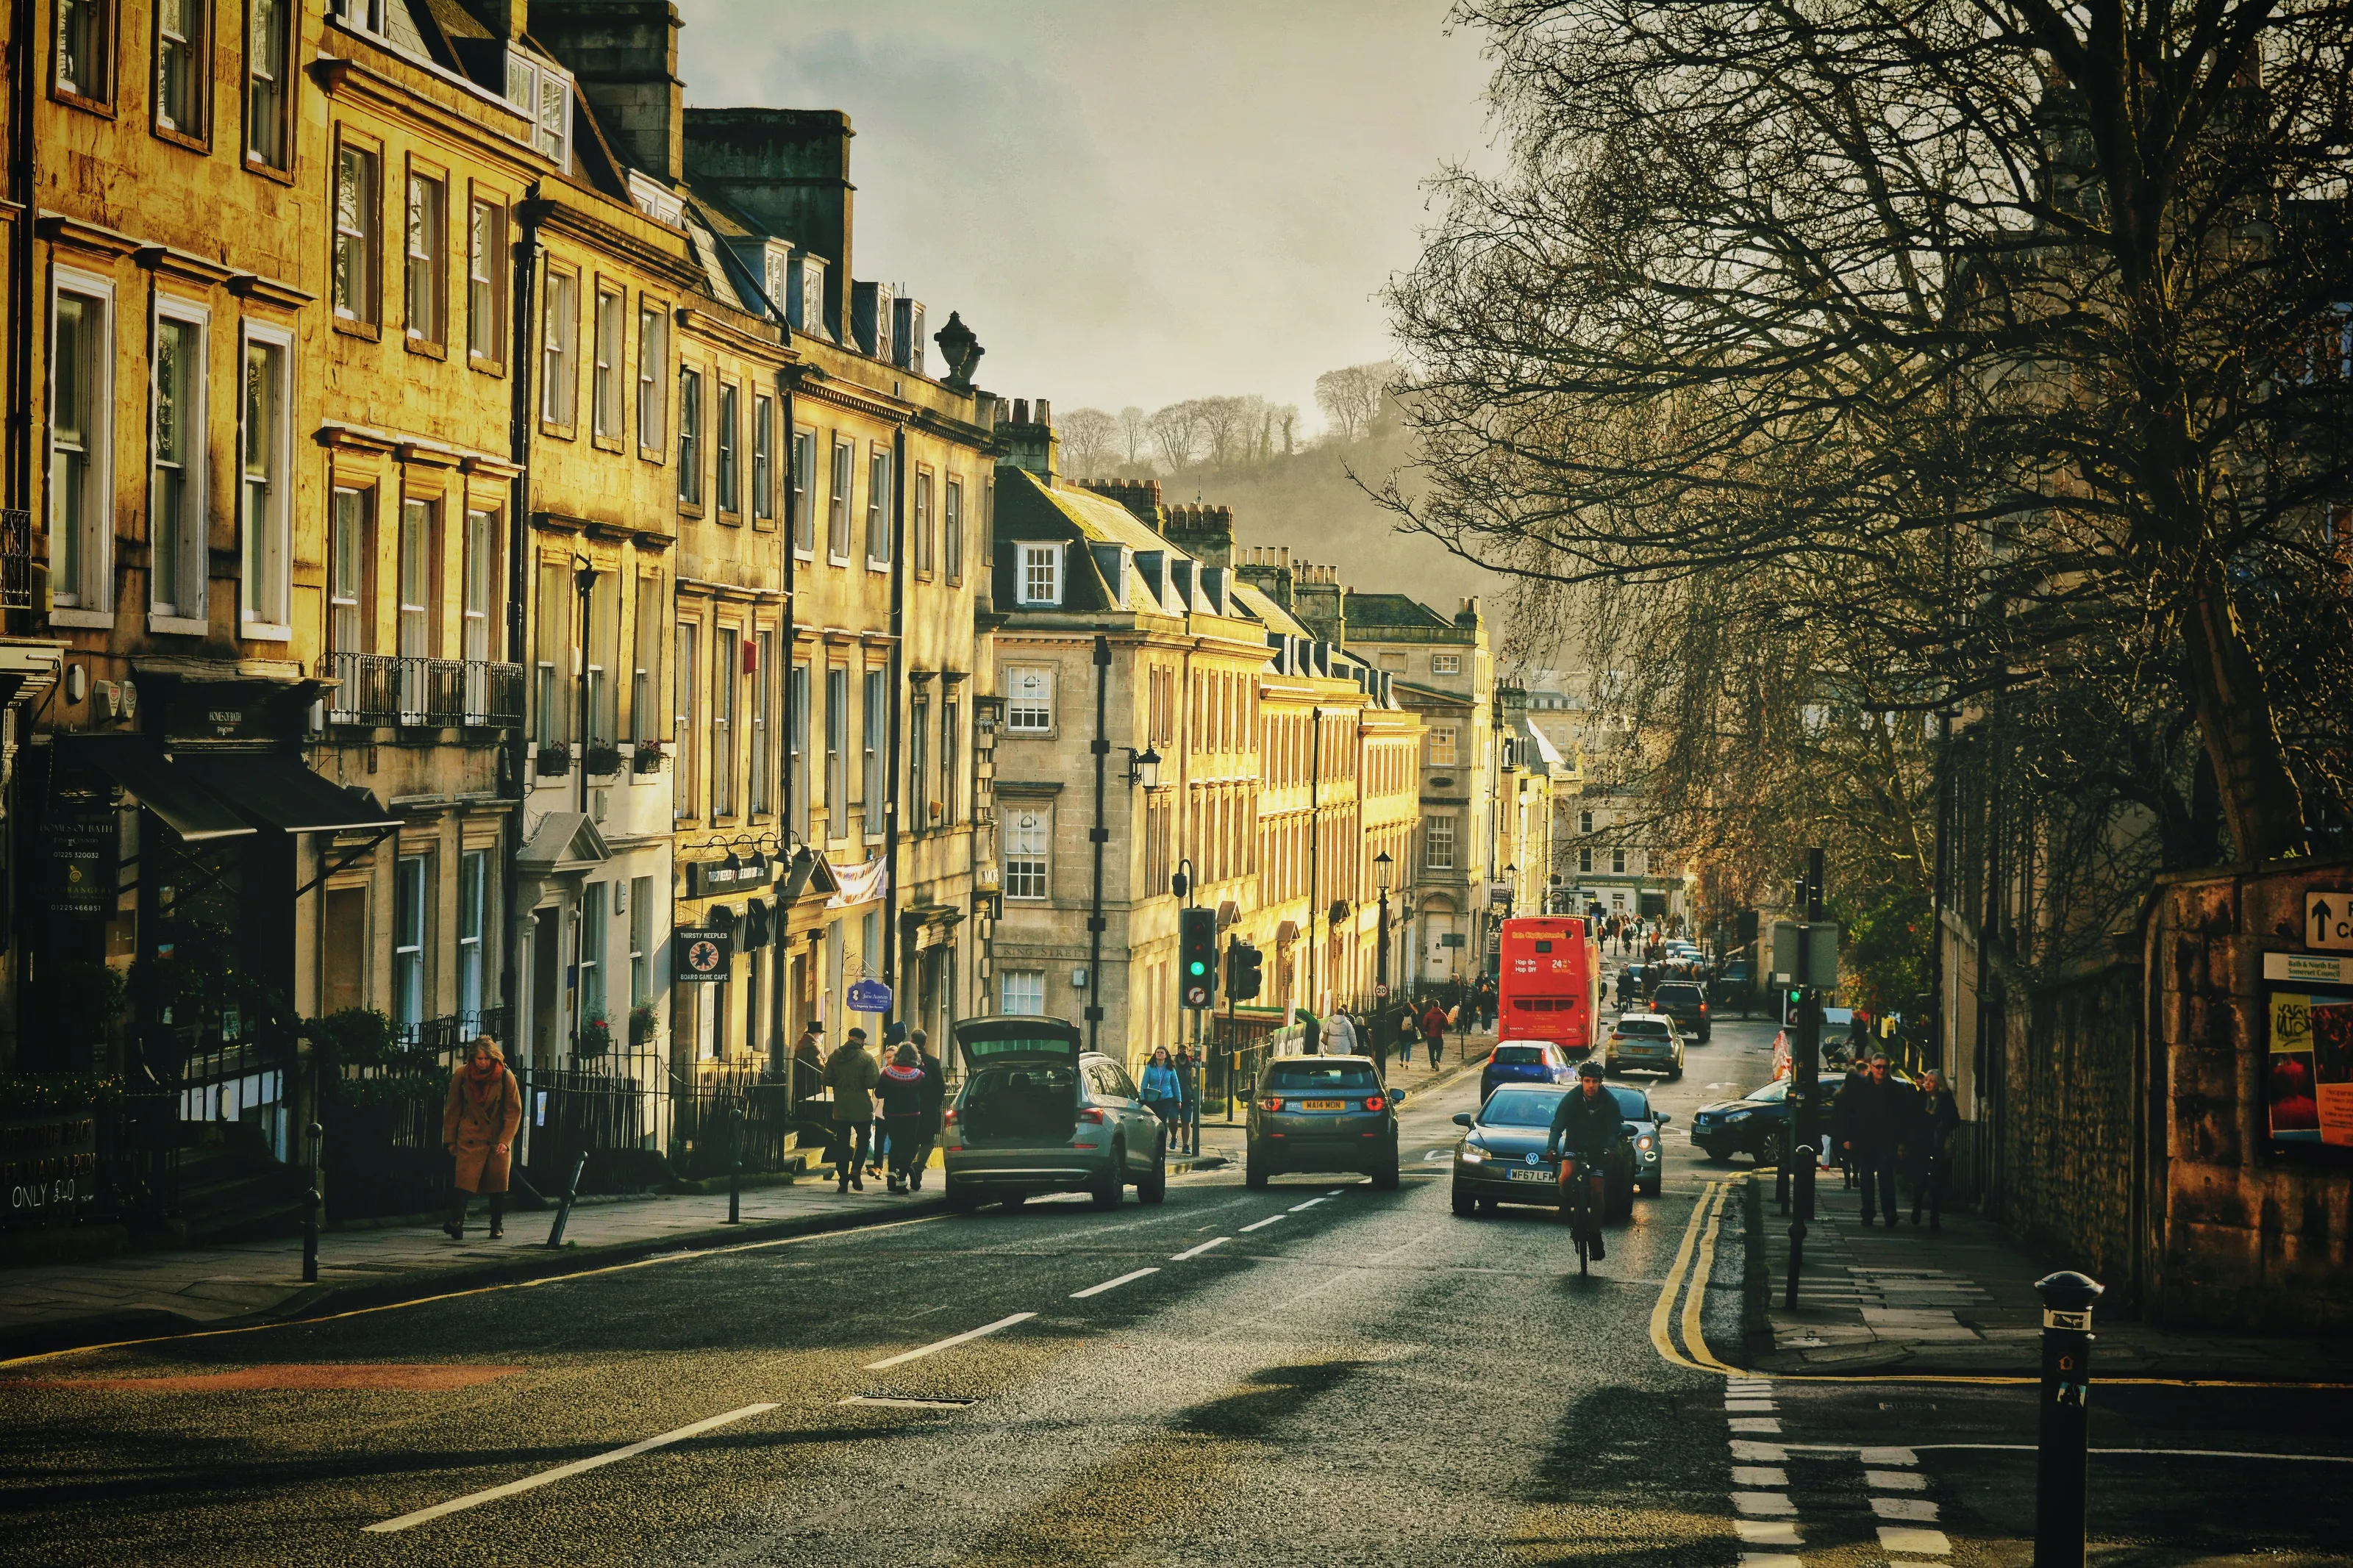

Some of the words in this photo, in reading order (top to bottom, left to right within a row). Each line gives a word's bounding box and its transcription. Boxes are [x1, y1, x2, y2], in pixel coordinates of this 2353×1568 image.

[209, 711, 224, 721] HOMES
[224, 712, 230, 721] OF
[230, 712, 241, 721] BATH
[40, 823, 72, 832] HOMES
[74, 824, 85, 832] OF
[88, 825, 113, 833] BATH
[1004, 947, 1032, 955] KING
[1041, 948, 1087, 957] STREET
[1552, 960, 1562, 968] 24
[1512, 1170, 1535, 1179] WF67
[12, 1183, 47, 1208] ONLY
[53, 1179, 74, 1203] £40
